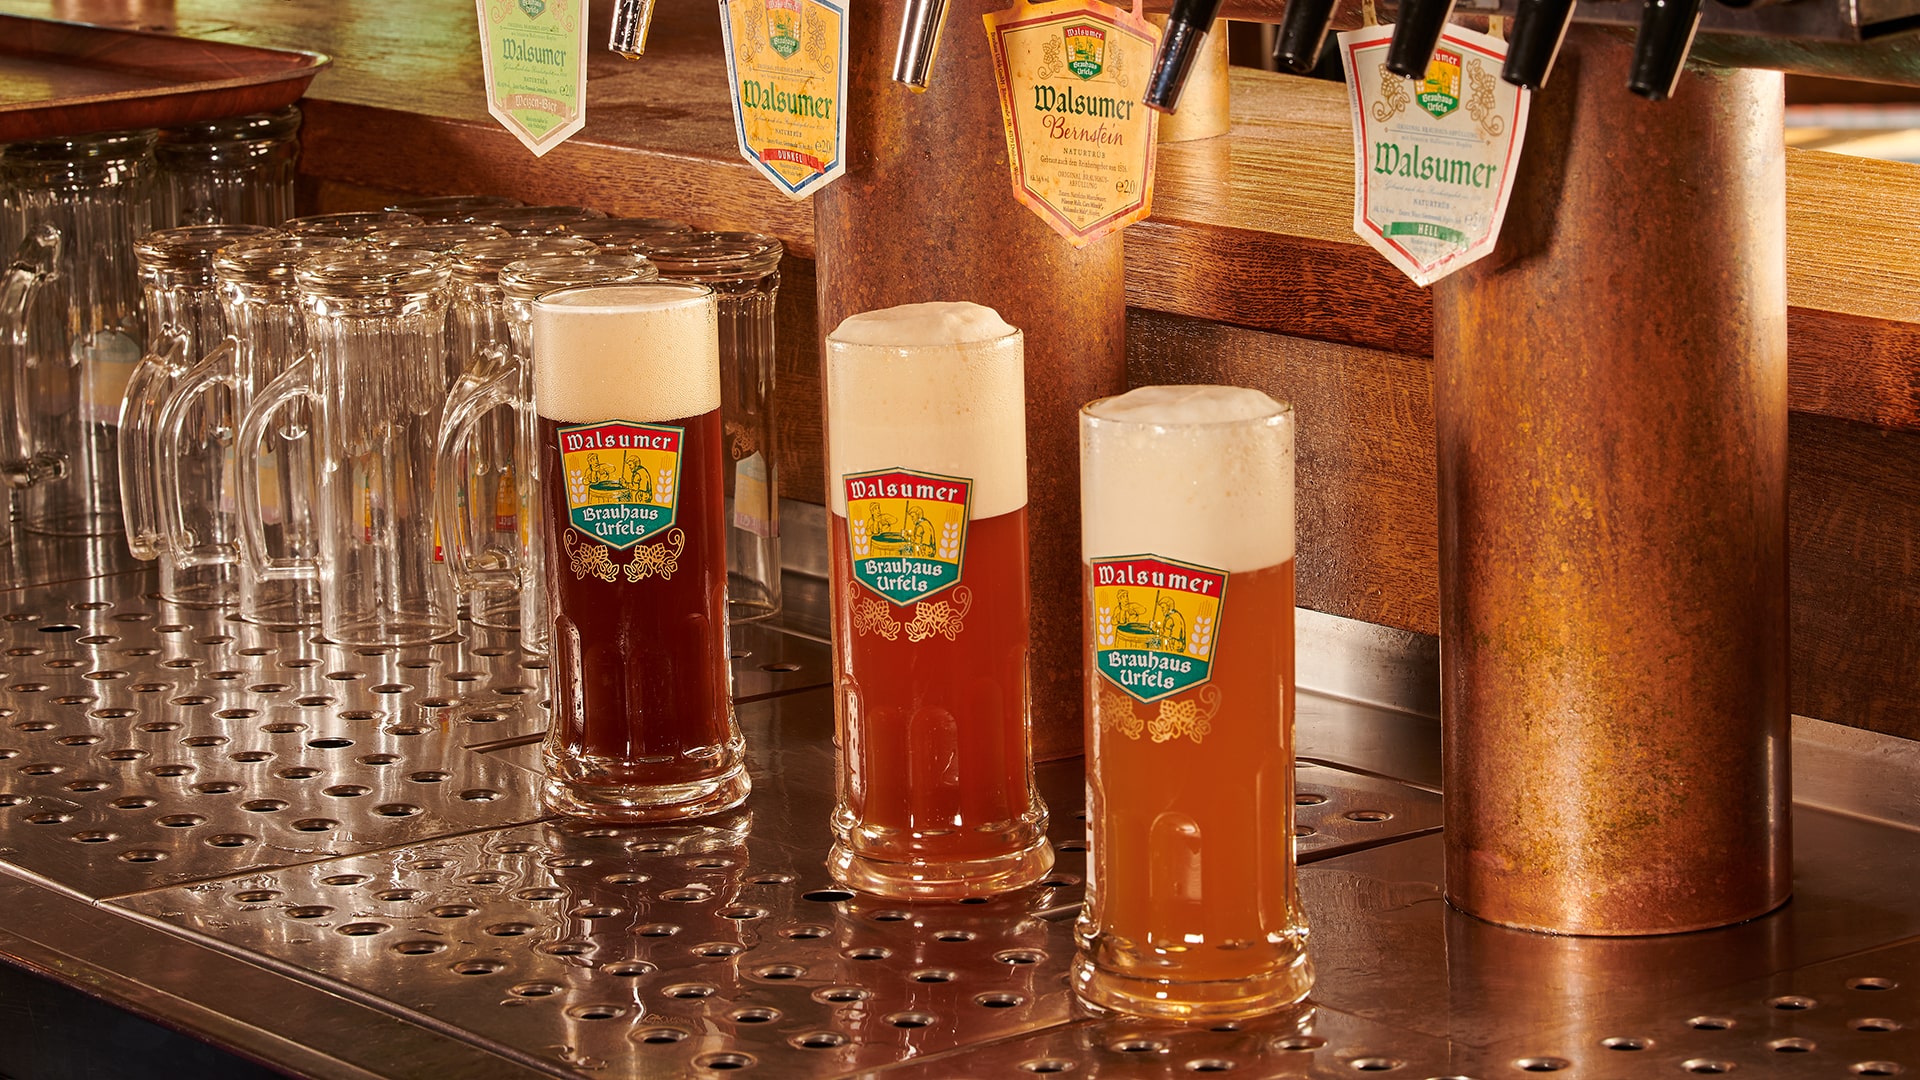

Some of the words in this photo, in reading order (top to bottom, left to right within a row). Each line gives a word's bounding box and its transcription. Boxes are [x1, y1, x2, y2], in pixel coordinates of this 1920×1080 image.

[1067, 27, 1103, 39] Walsumer
[503, 38, 567, 67] Walsumer
[515, 95, 558, 113] Weizen-Bier
[744, 80, 833, 119] Walsumer
[1034, 84, 1135, 121] Walsumer
[1422, 93, 1453, 105] Brauhaus
[1427, 102, 1448, 113] Urfels
[1042, 114, 1124, 148] Bernstein
[777, 150, 804, 163] DUNKEL
[1063, 147, 1106, 159] NATURTRÜB
[1374, 141, 1498, 189] Walsumer
[1417, 223, 1439, 237] HELL
[567, 431, 672, 451] Walsumer
[850, 479, 958, 501] Walsumer
[582, 504, 659, 521] Brauhaus
[594, 520, 645, 536] Urfels
[864, 558, 943, 576] Brauhaus
[876, 575, 928, 592] Urfels
[1098, 565, 1214, 594] Walsumer
[1108, 651, 1192, 674] Brauhaus
[1120, 669, 1175, 689] Urfels
